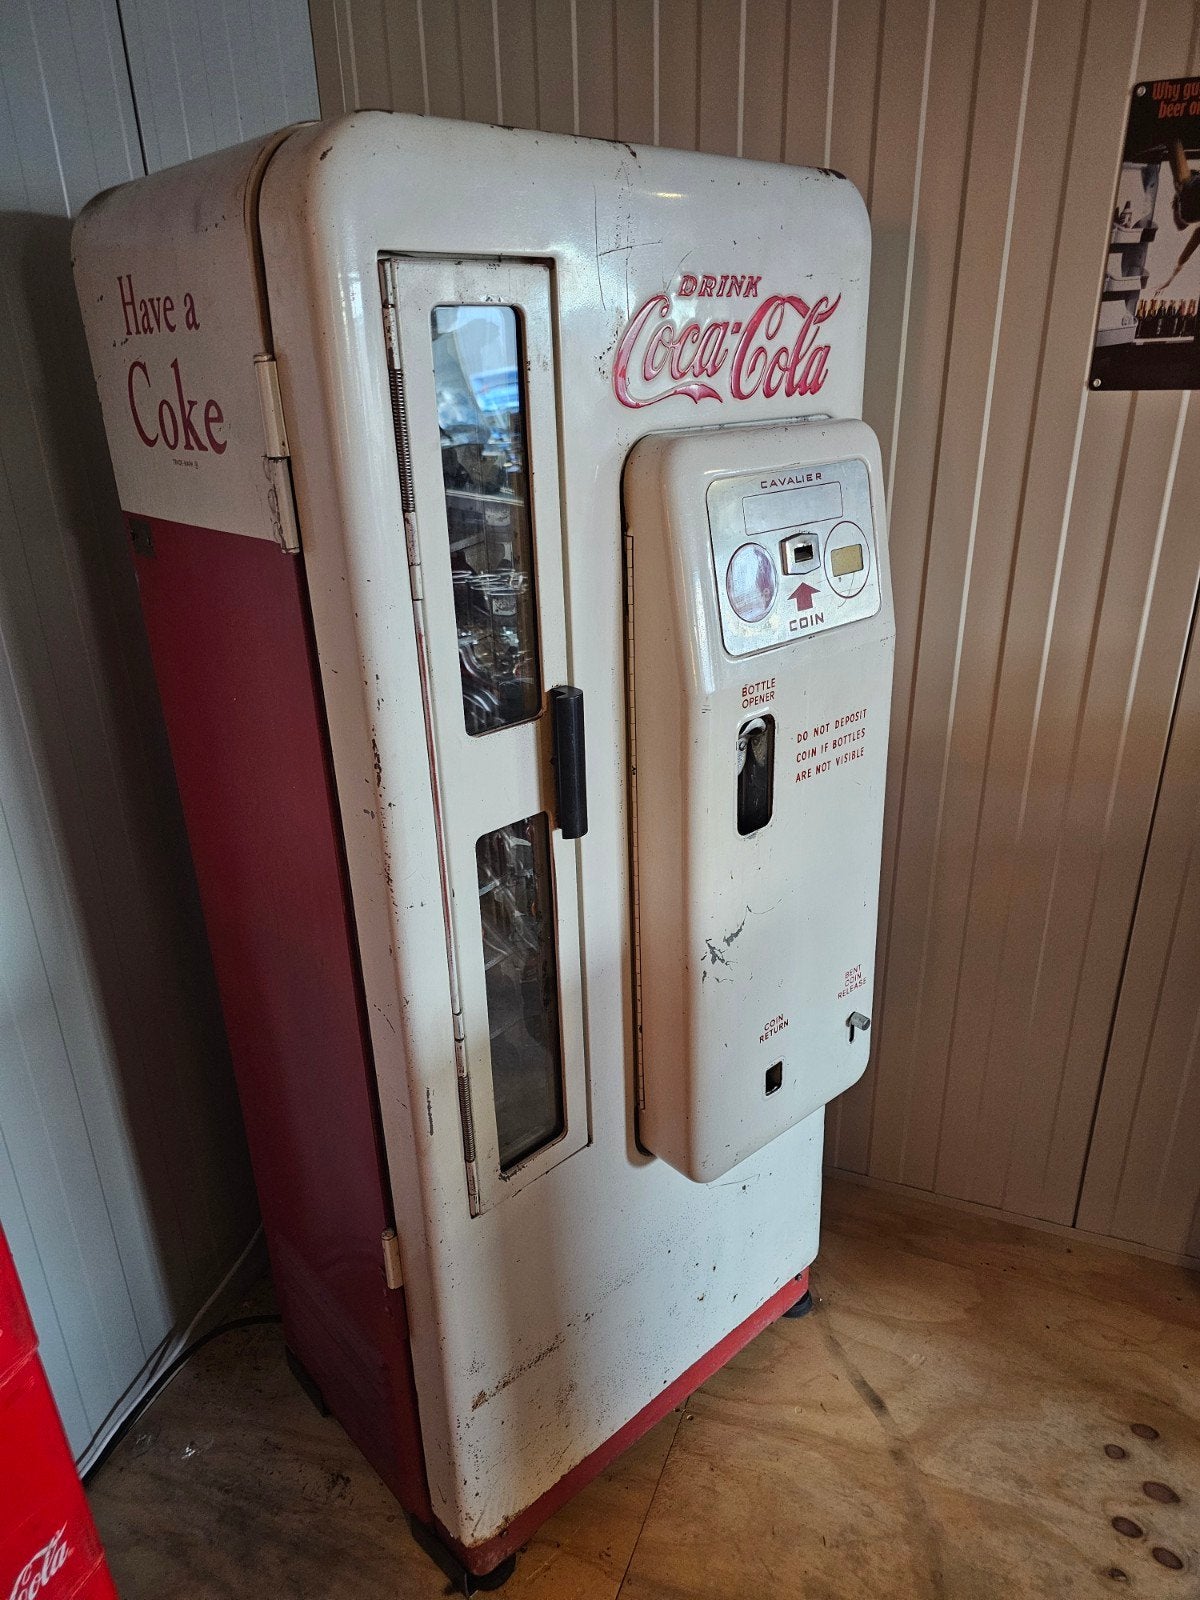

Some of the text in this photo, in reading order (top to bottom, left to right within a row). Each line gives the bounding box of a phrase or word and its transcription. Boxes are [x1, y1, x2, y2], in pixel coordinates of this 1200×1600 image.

[1152, 81, 1180, 101] Why
[1159, 101, 1187, 119] beer
[678, 274, 762, 298] DRINK
[117, 274, 200, 336] Have a
[612, 292, 842, 409] Coca-Cola
[127, 357, 228, 455] Coke
[760, 472, 823, 489] CAVALIER
[789, 612, 825, 632] COIN
[741, 677, 776, 697] BOTTLE
[741, 690, 776, 709] OPENER
[797, 708, 868, 744] DO NOT DEPOSIT
[796, 727, 866, 763] COIN IF BOTTLES
[795, 746, 866, 783] ARE NOT VISIBLE
[845, 964, 862, 979] BENT
[845, 972, 862, 987] COIN
[837, 977, 867, 999] RELEASE
[759, 1019, 789, 1044] RETURN
[764, 1013, 784, 1031] COIN
